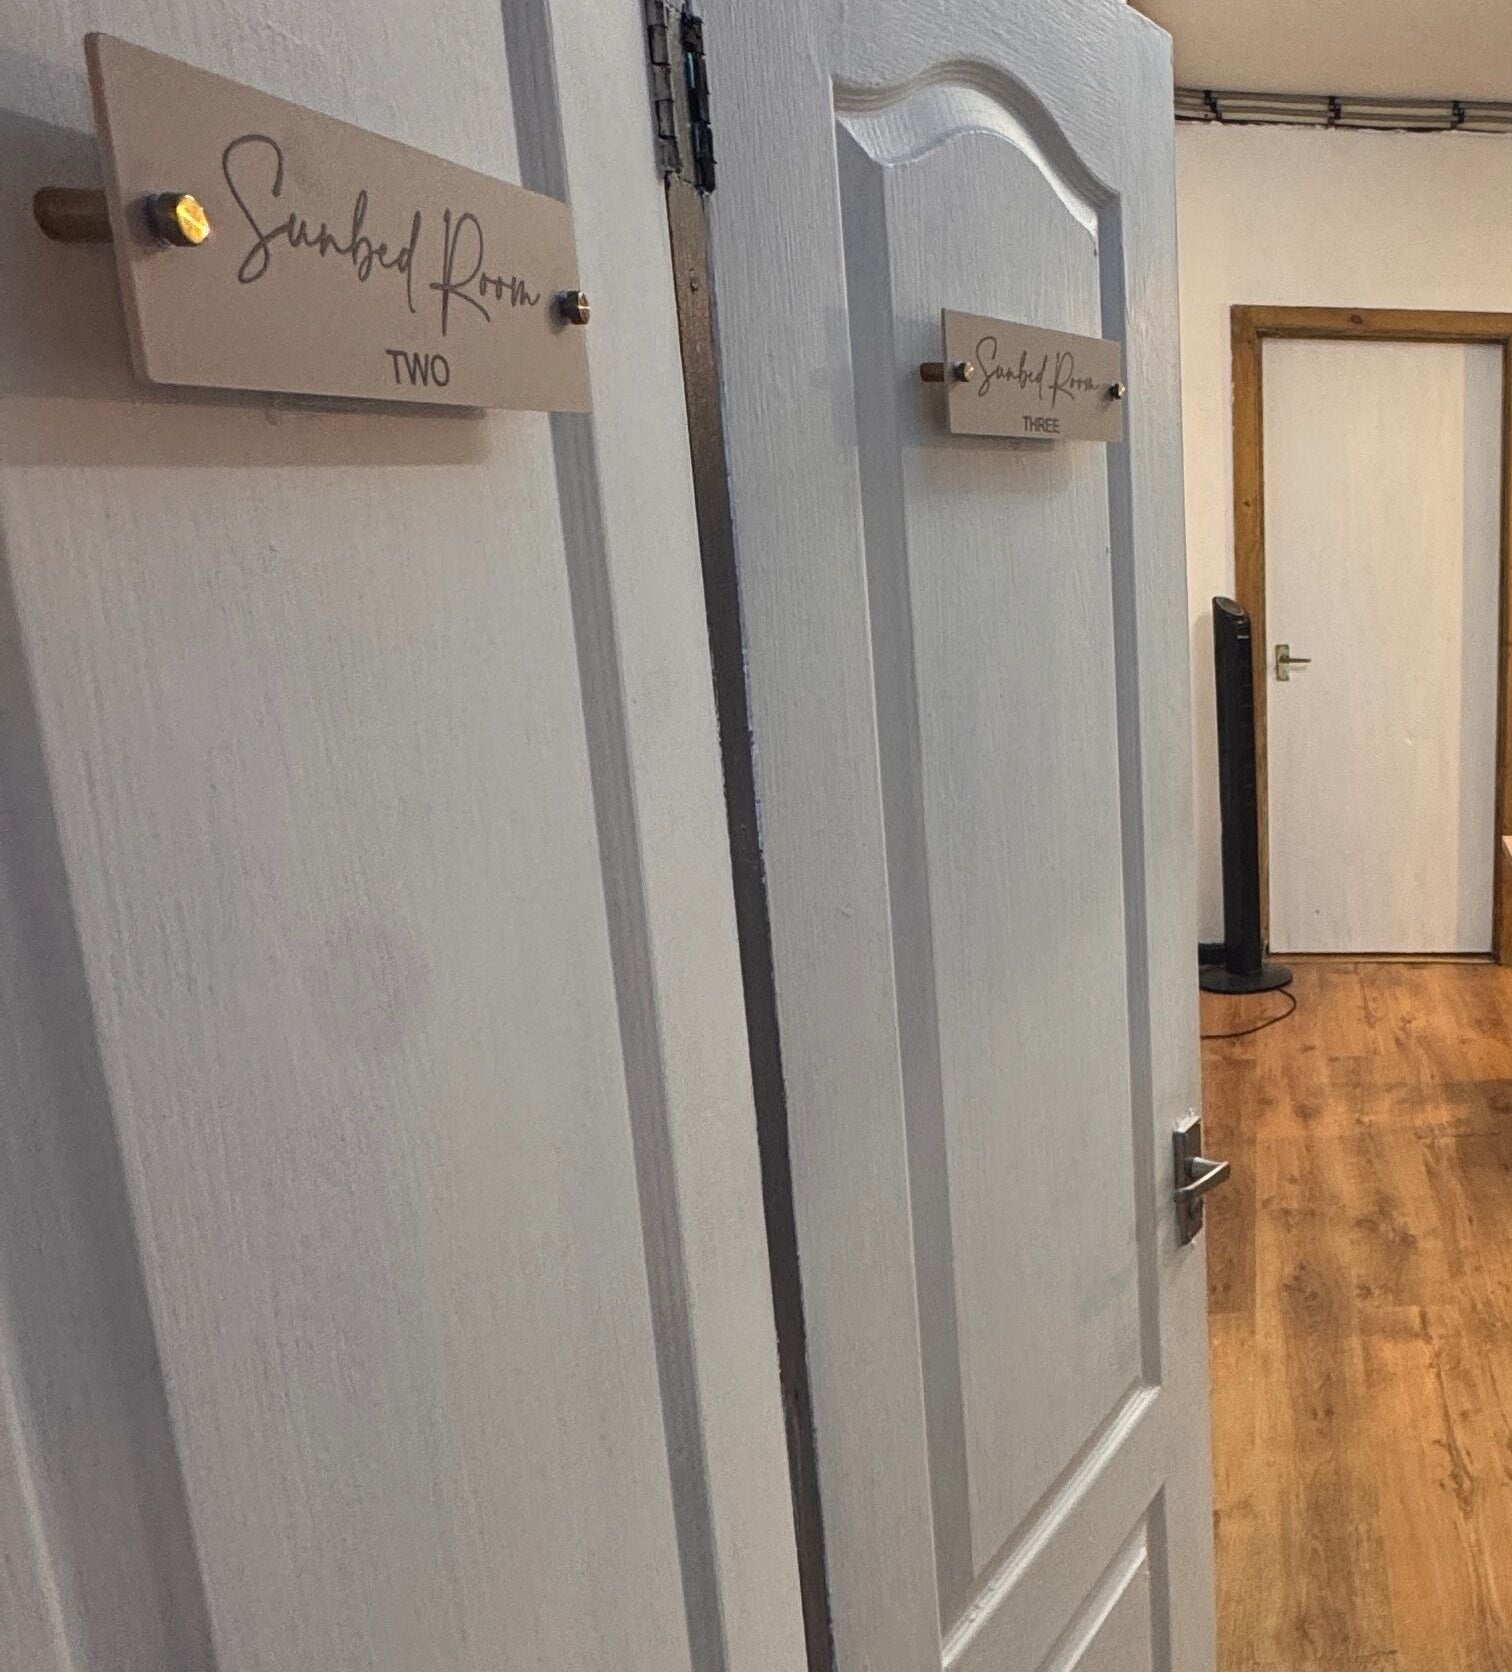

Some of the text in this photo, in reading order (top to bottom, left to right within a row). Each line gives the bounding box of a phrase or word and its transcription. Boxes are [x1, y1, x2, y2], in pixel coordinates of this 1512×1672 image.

[222, 133, 541, 337] Sunbed Room
[386, 349, 450, 388] TWO
[975, 336, 1099, 409] Sunbed Room
[1022, 415, 1061, 435] THREE
